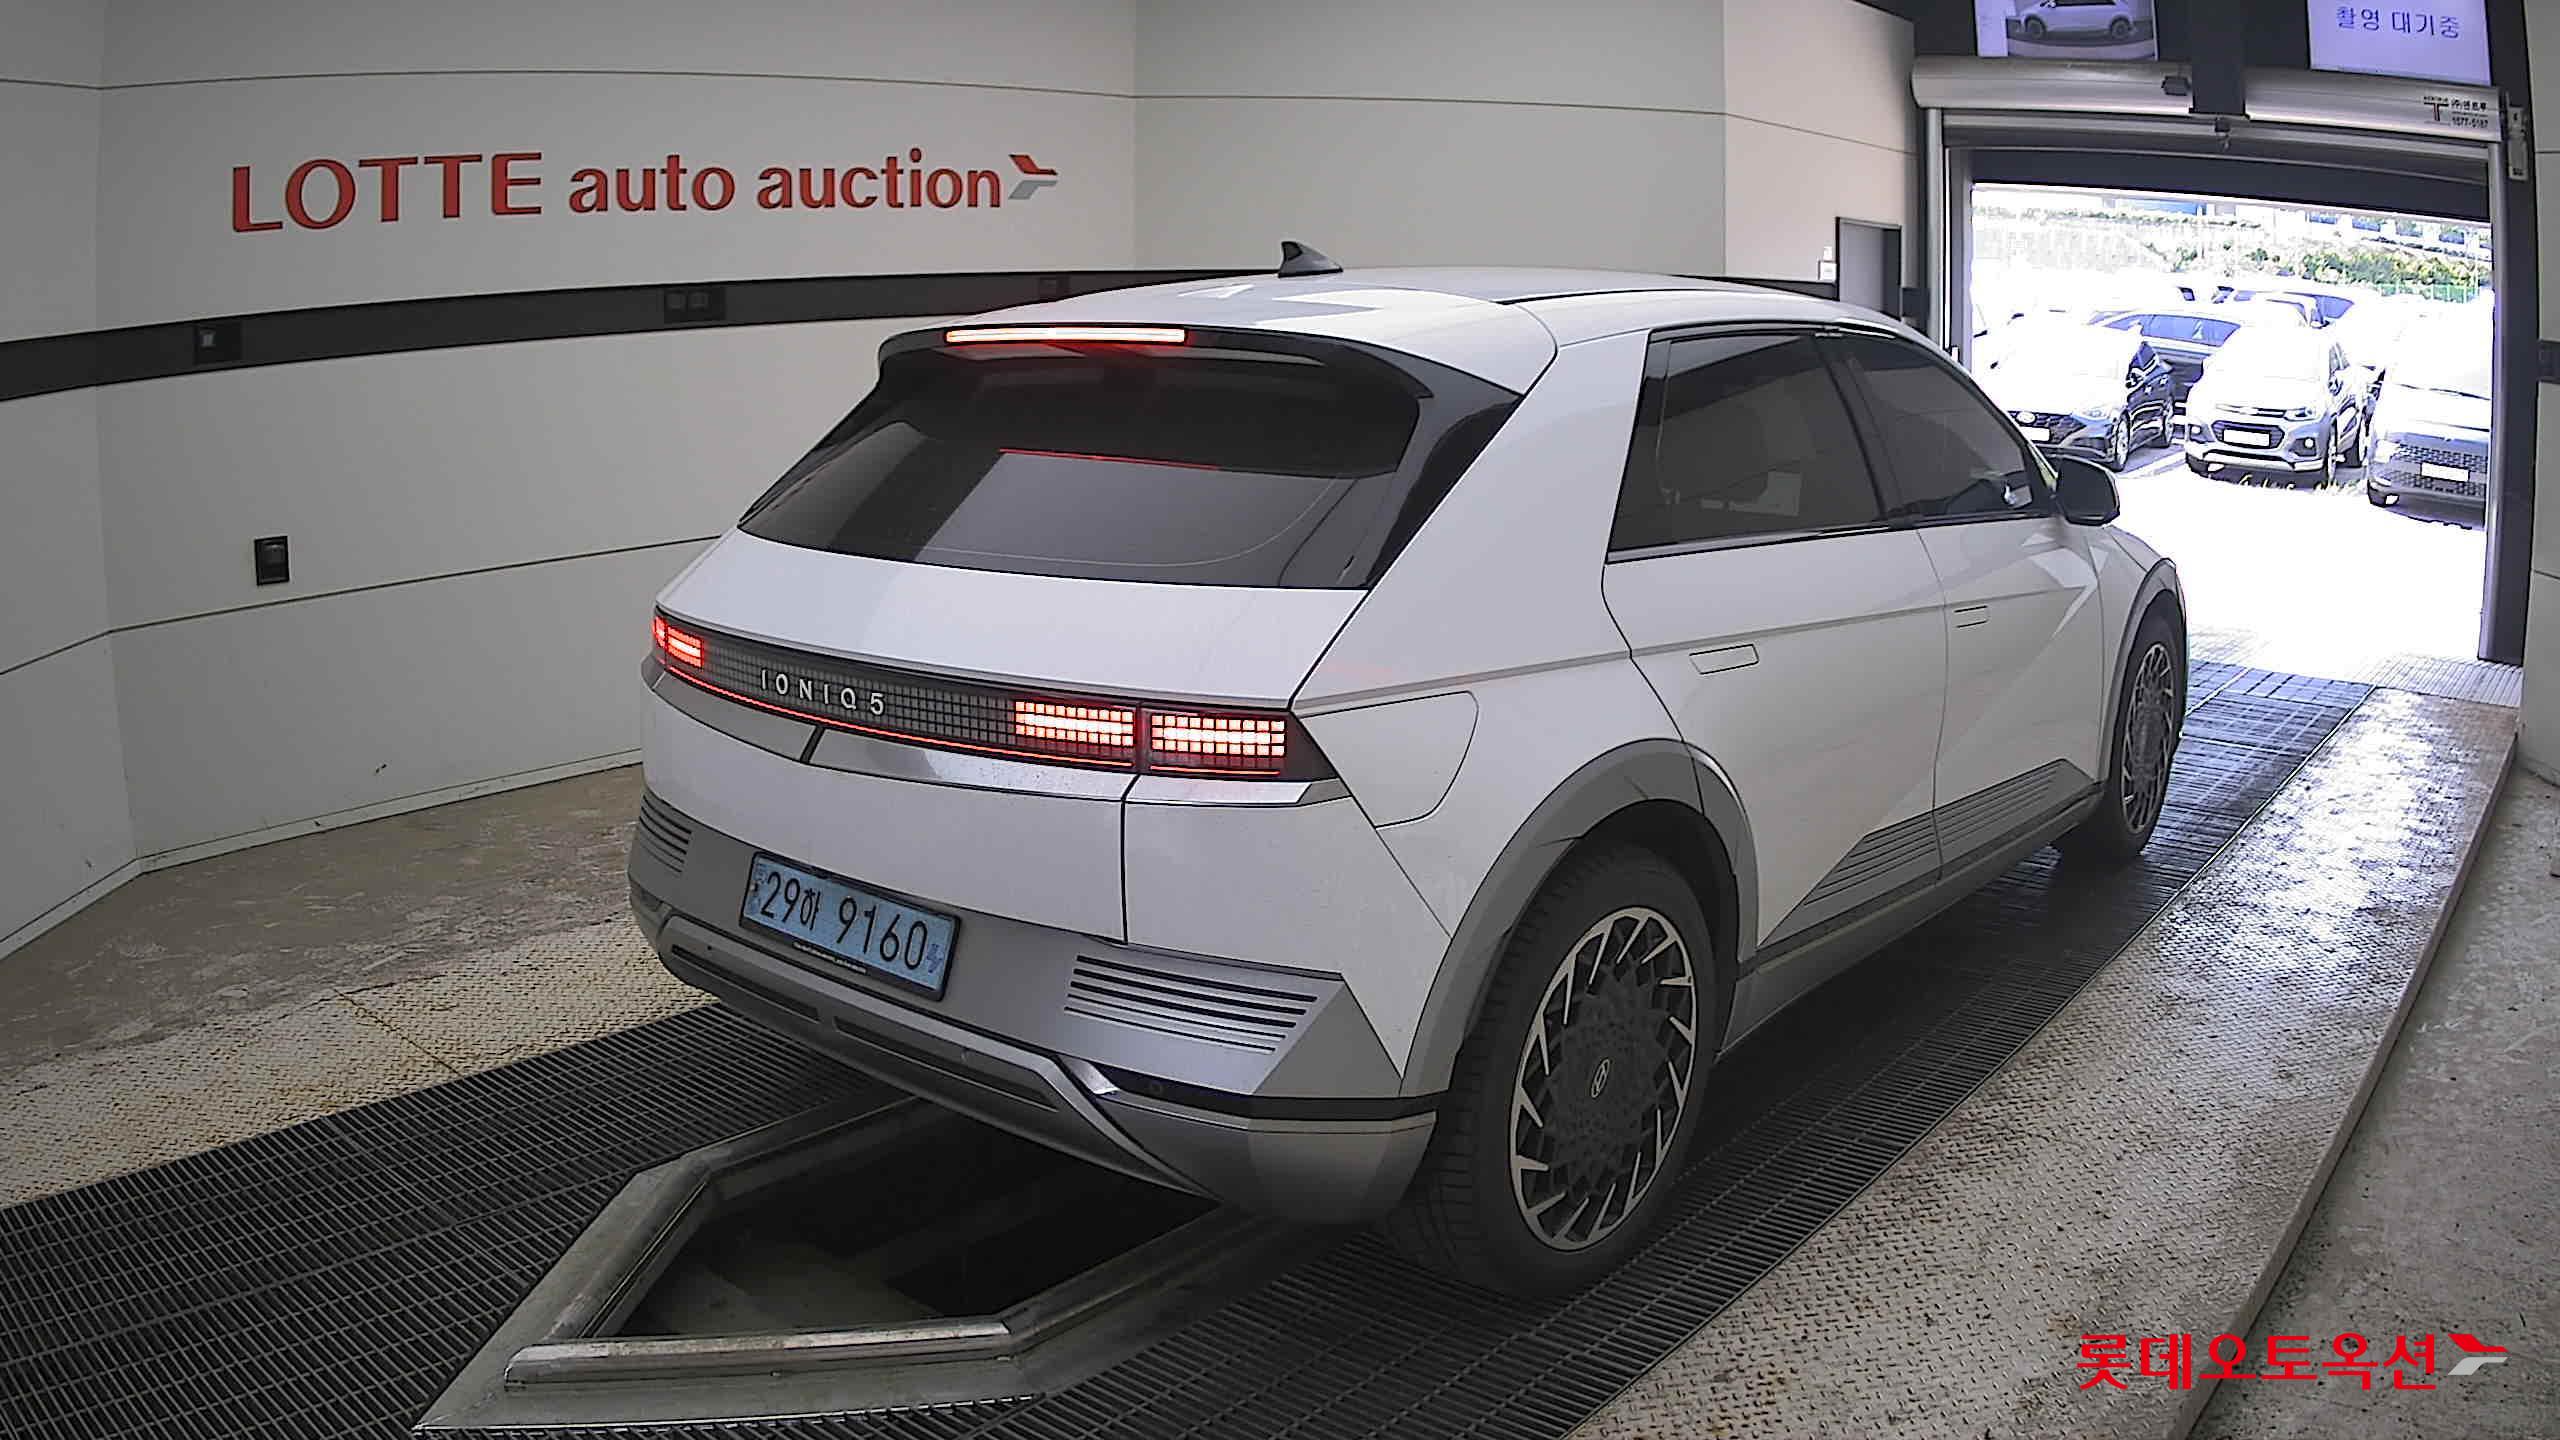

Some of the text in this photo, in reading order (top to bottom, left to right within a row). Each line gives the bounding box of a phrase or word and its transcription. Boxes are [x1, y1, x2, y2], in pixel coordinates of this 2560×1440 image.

[2336, 6, 2460, 39] 촬영 대기중
[232, 148, 1001, 233] LOTTE auto auction
[761, 669, 884, 716] IONIQ 5
[760, 871, 821, 931] 29하
[836, 897, 928, 970] 9160
